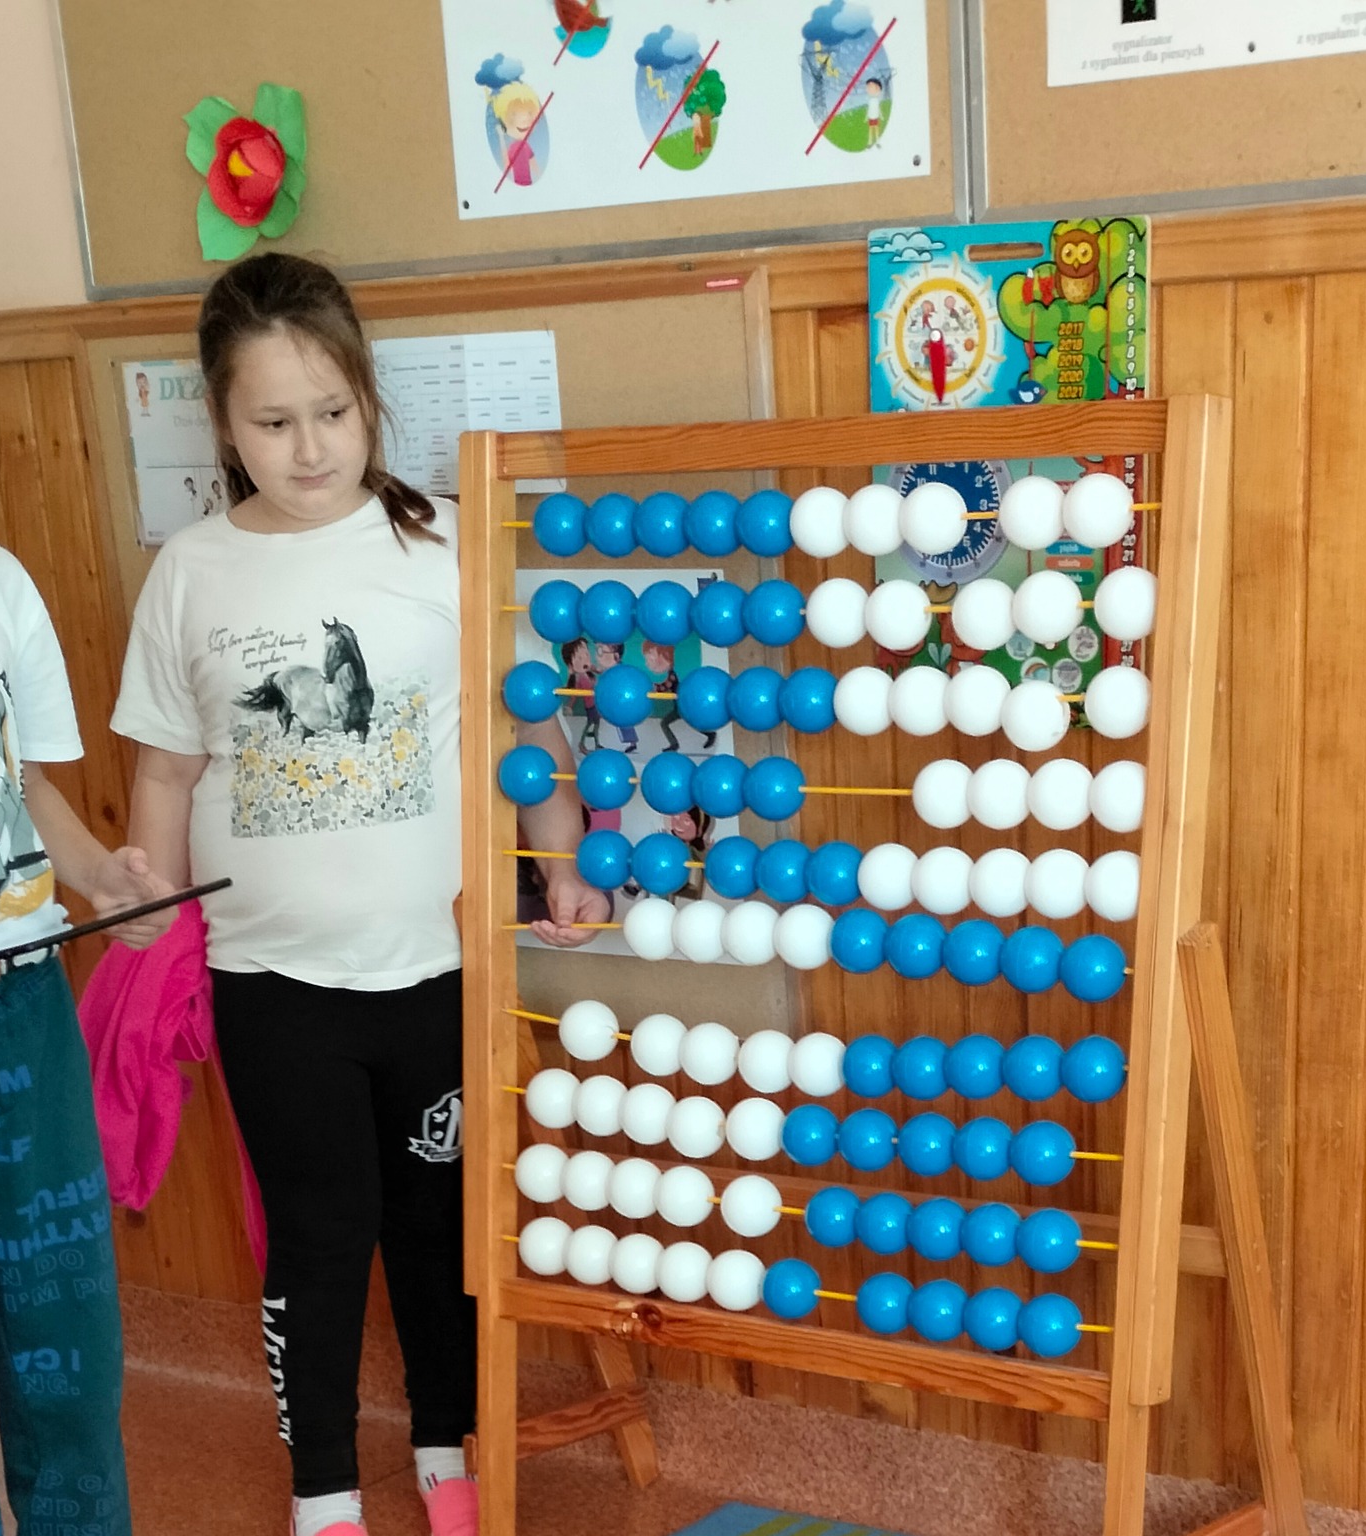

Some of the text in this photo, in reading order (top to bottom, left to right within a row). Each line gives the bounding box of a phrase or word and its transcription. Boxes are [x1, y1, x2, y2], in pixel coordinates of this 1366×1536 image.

[1142, 50, 1158, 63] dla
[1128, 233, 1134, 245] 1
[1127, 248, 1135, 262] 2
[1127, 298, 1134, 311] 5
[1127, 313, 1135, 327] 6
[1058, 321, 1084, 336] 2017
[1127, 330, 1134, 343] 7
[1058, 338, 1083, 352] 2018
[1127, 346, 1135, 359] 8
[1057, 354, 1083, 368] 2019
[1127, 362, 1135, 375] 9
[1057, 369, 1083, 384] 2020
[1126, 377, 1137, 391] 10
[1057, 385, 1083, 400] 2021
